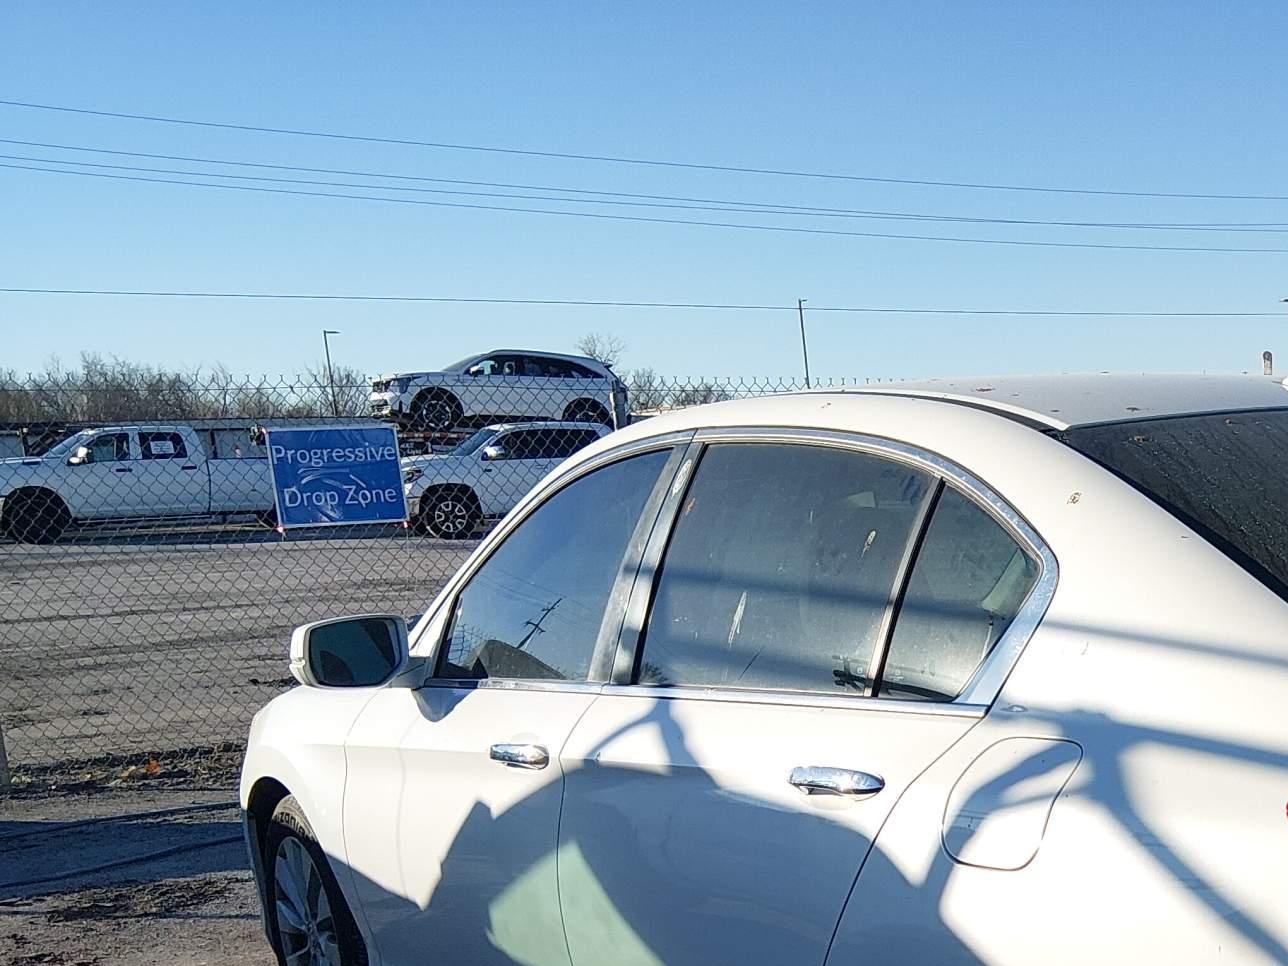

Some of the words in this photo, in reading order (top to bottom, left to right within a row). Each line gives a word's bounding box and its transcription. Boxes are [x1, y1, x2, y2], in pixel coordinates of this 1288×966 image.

[271, 442, 396, 467] Progressive
[283, 487, 339, 511] Drop
[342, 485, 397, 505] Zone
